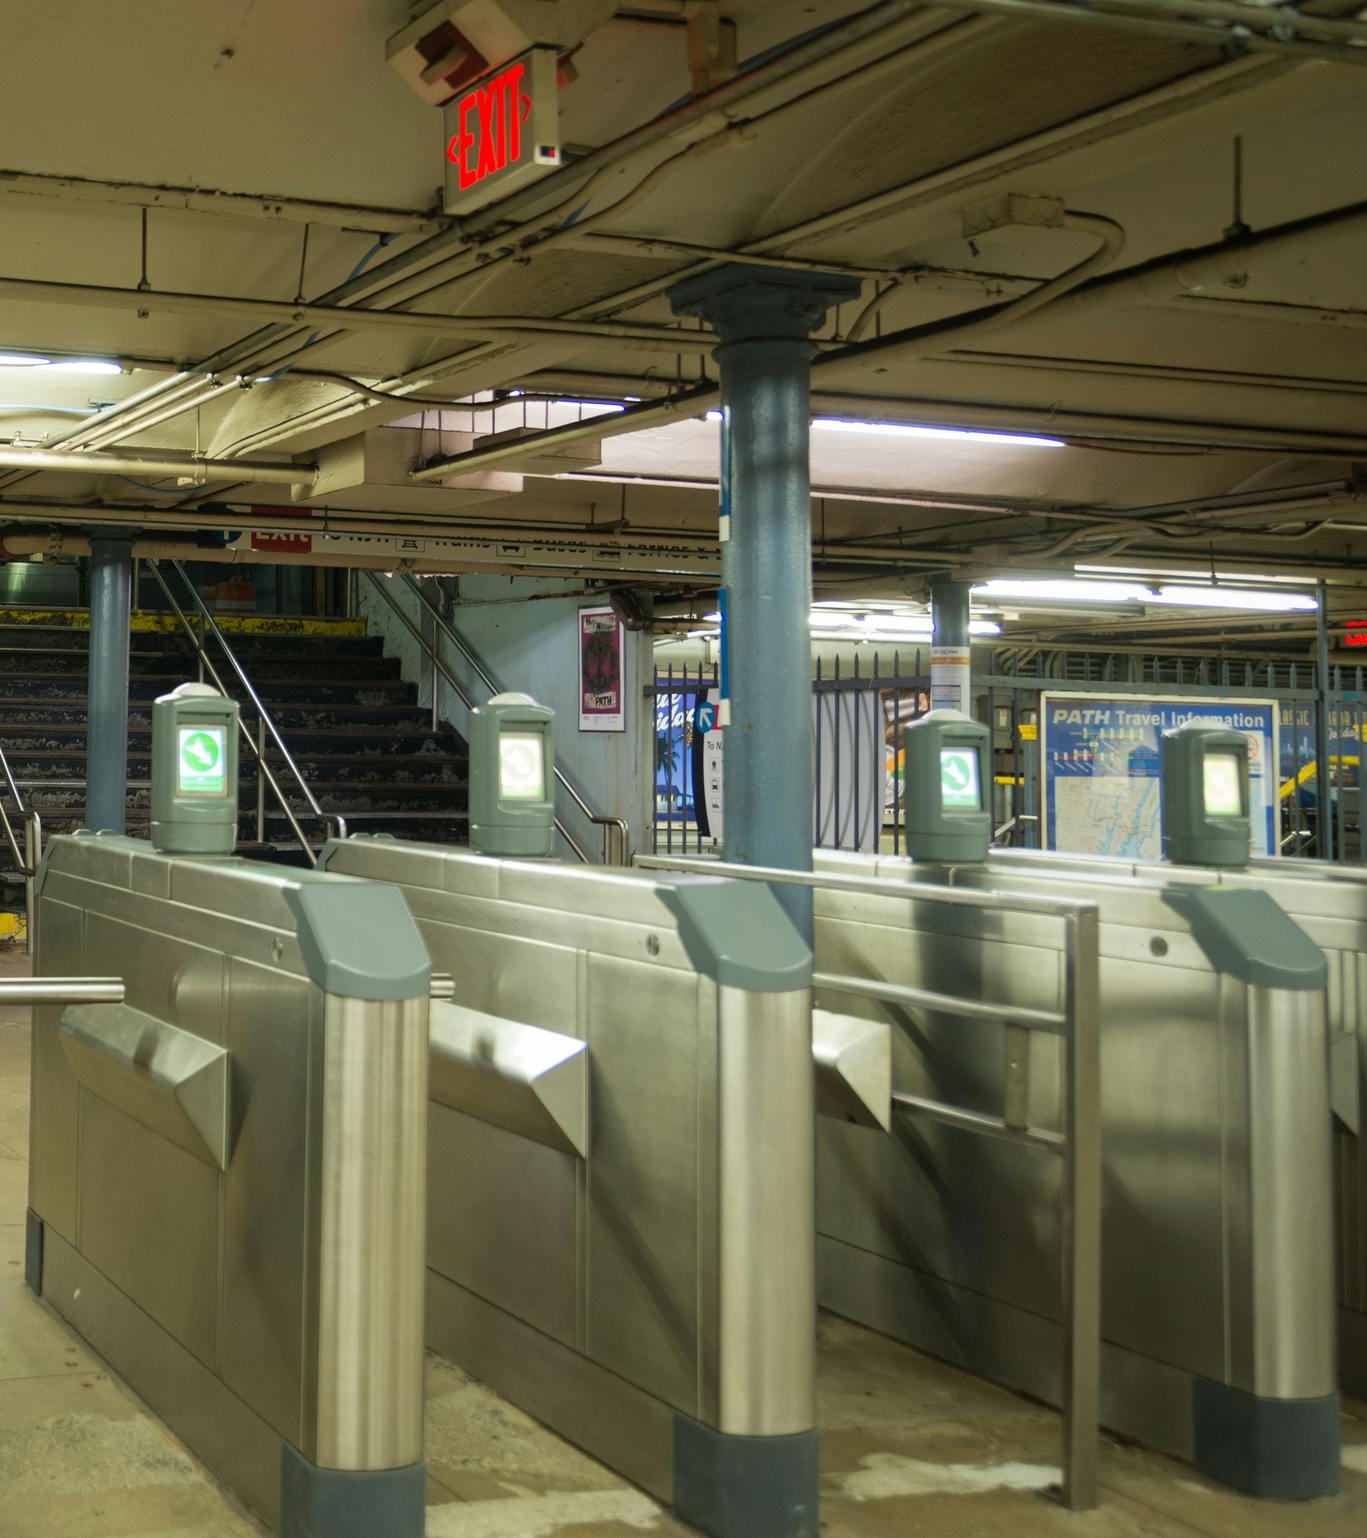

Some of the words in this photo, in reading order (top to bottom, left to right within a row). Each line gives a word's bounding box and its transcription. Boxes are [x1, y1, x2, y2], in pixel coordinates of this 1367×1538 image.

[459, 63, 524, 191] EXIT
[595, 696, 612, 707] PATH
[1053, 709, 1111, 725] PATH
[1116, 710, 1165, 726] Travel
